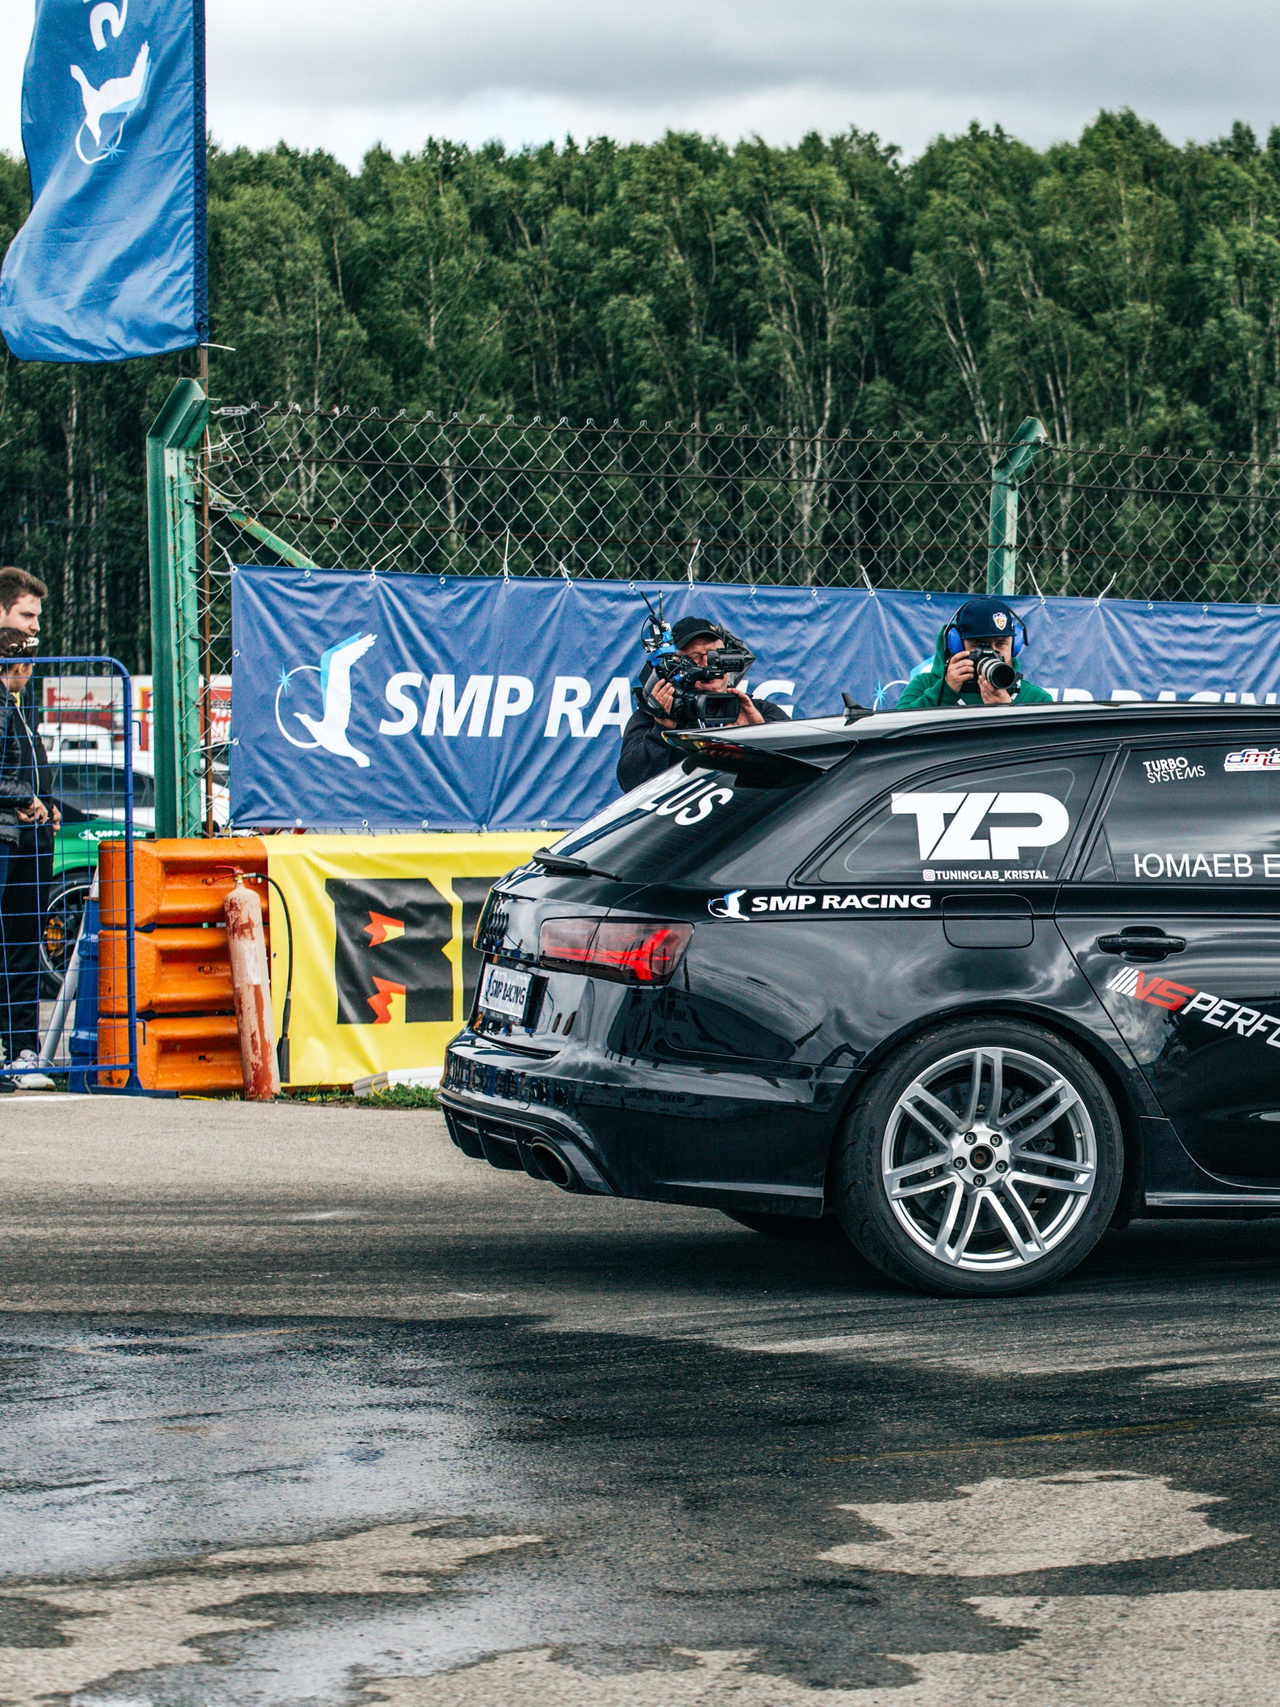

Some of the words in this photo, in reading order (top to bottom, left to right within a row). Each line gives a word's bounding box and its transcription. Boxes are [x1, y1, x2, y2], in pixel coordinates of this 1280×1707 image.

[379, 672, 534, 737] SMP
[1143, 757, 1189, 773] TURBO
[1146, 765, 1206, 784] SYSTEMS
[1134, 853, 1253, 878] ЮМАЕВ
[936, 869, 1049, 882] TUNINGLAB_KRISTAL
[751, 895, 816, 912] SMP
[822, 894, 932, 909] RACING
